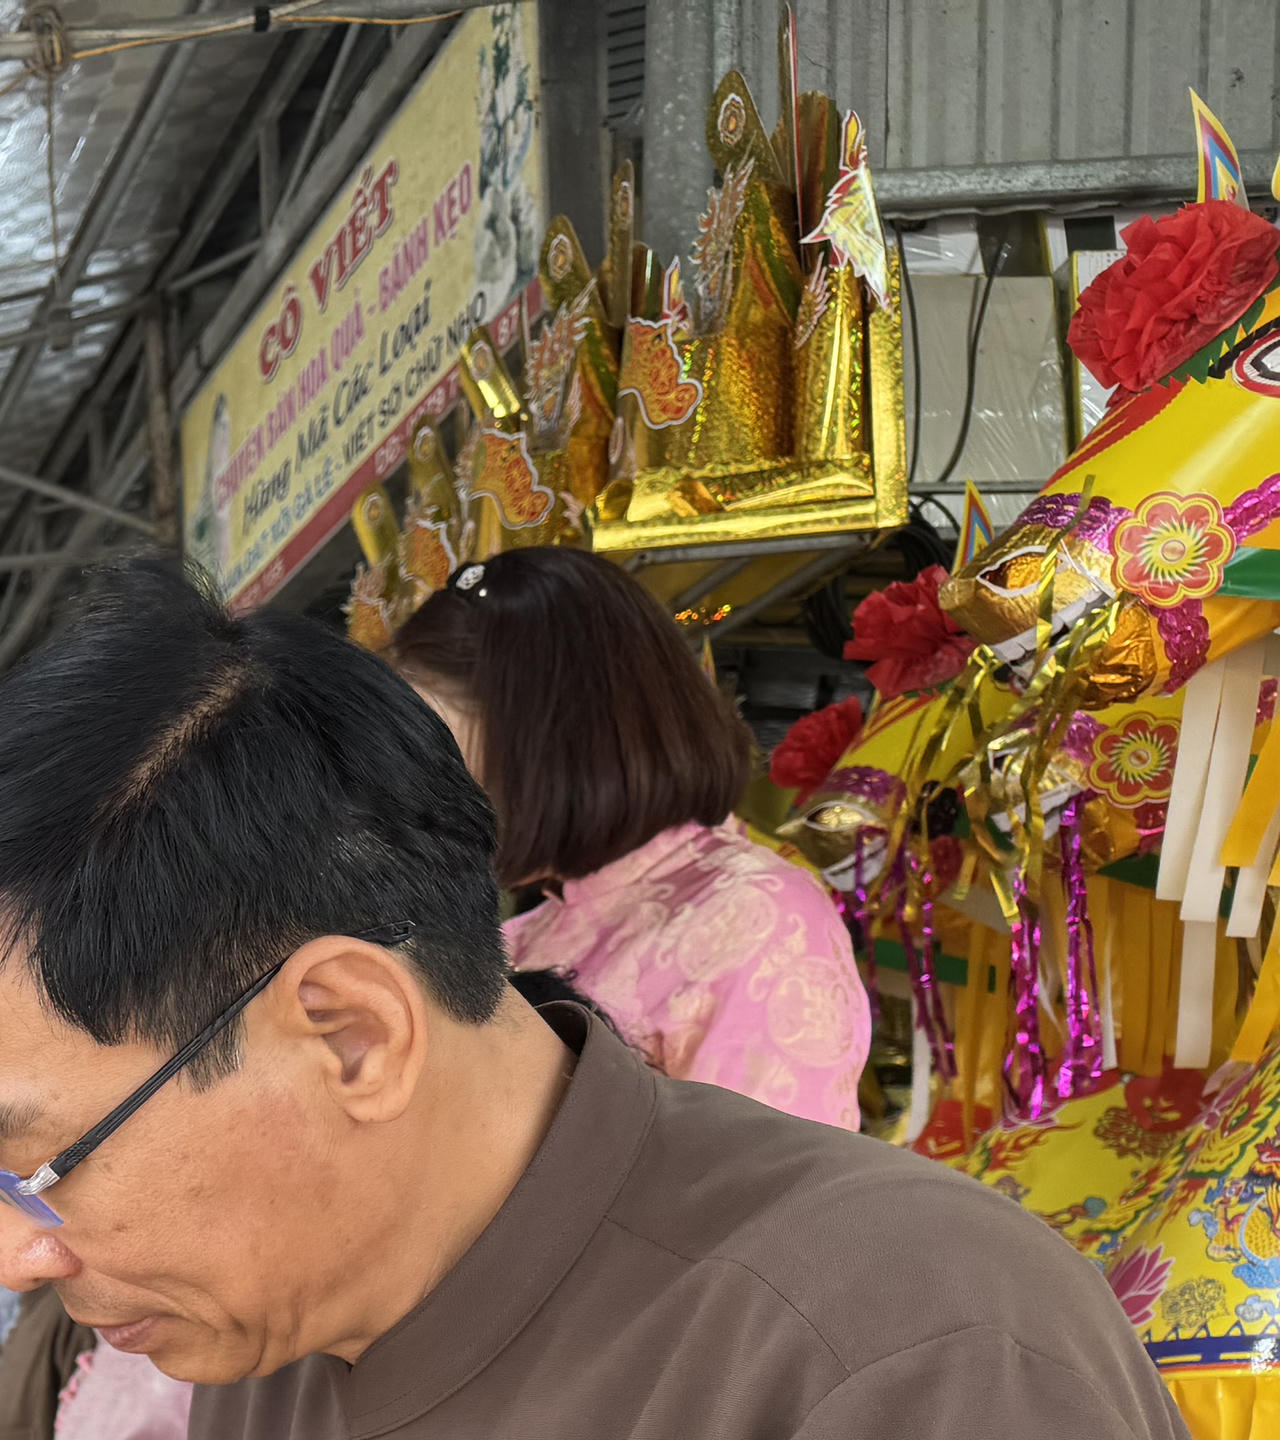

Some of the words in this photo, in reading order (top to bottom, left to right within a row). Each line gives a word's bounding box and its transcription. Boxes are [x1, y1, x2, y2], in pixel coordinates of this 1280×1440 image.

[258, 281, 301, 381] CÔ
[308, 156, 397, 310] VIẾT
[378, 218, 430, 312] BÁNH
[433, 163, 473, 249] KẸO
[333, 360, 375, 432] Các
[379, 278, 433, 378] Loại
